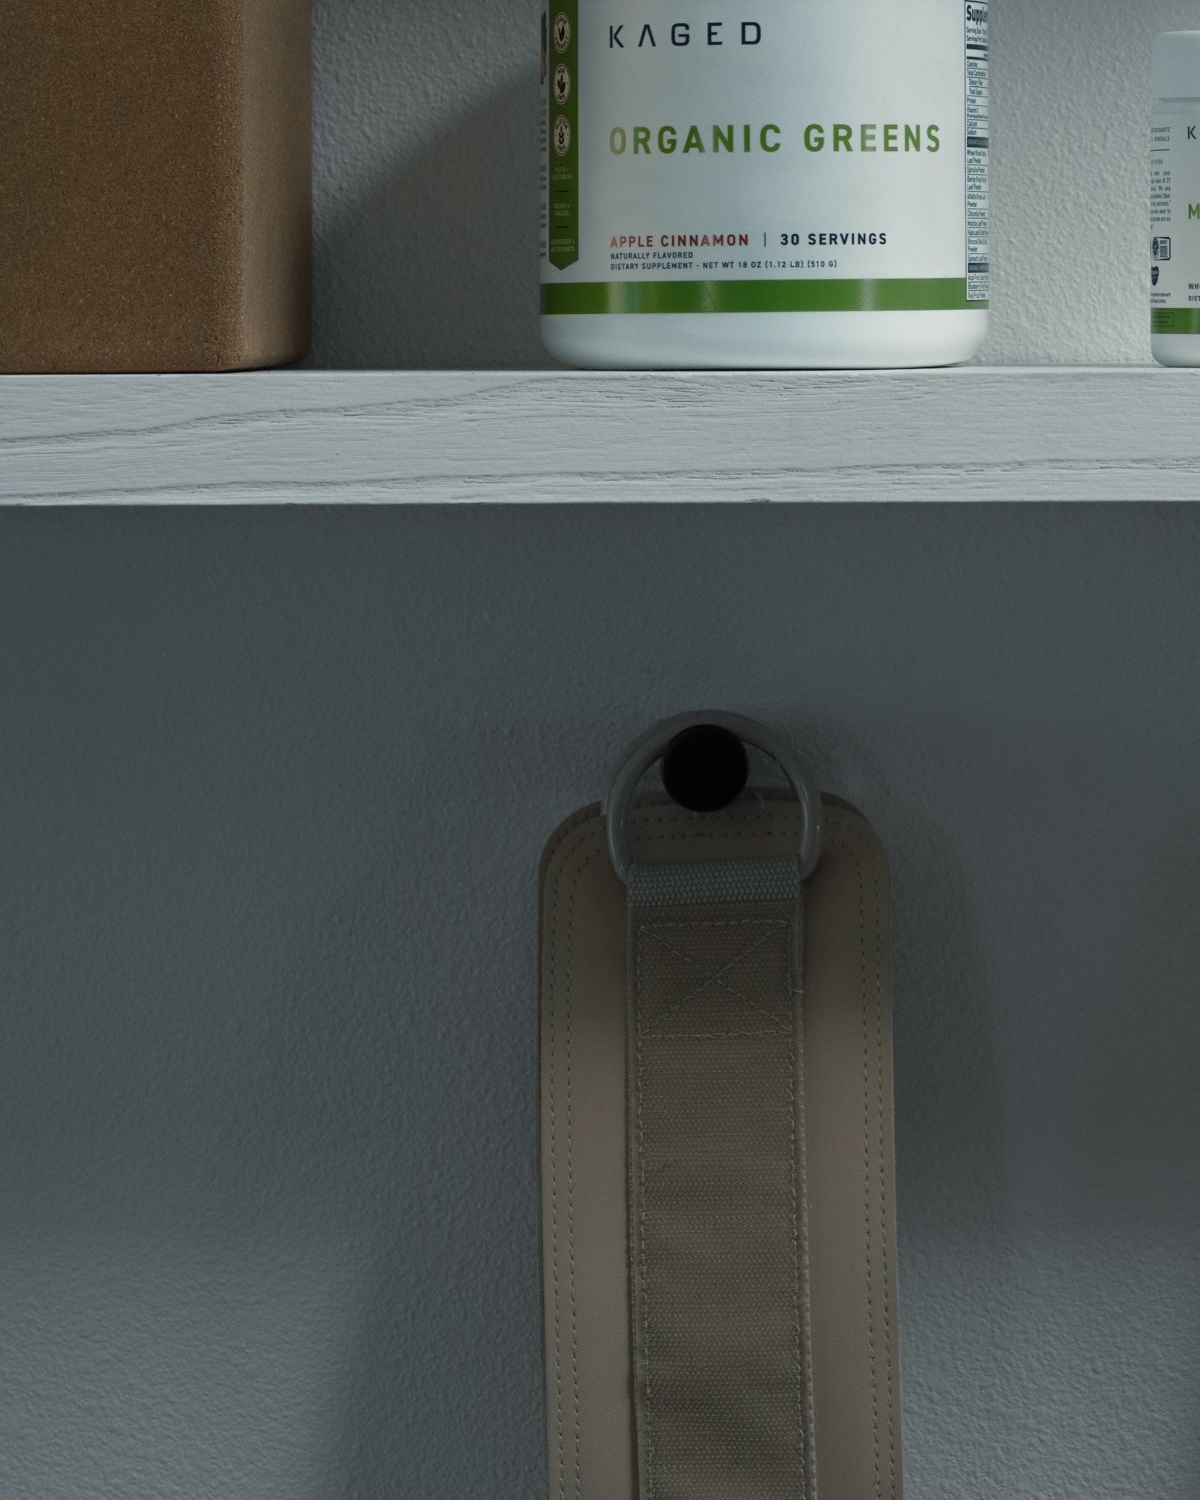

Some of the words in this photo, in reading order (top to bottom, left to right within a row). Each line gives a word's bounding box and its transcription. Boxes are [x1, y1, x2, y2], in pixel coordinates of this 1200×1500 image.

[609, 22, 762, 48] KAGED
[610, 124, 781, 155] ORGANIC
[803, 124, 940, 152] GREENS
[610, 236, 654, 247] APPLE
[661, 234, 749, 247] CINNAMON
[781, 234, 800, 245] 30
[808, 233, 887, 245] SERVINGS
[611, 252, 651, 261] NATURALLY
[653, 252, 694, 260] FLAVORED
[611, 263, 639, 271] DIETARY
[642, 262, 694, 270] SUPPLEMENT
[751, 261, 762, 269] OZ
[790, 260, 804, 269] LB)
[807, 260, 825, 268] (510
[828, 260, 838, 269] G)
